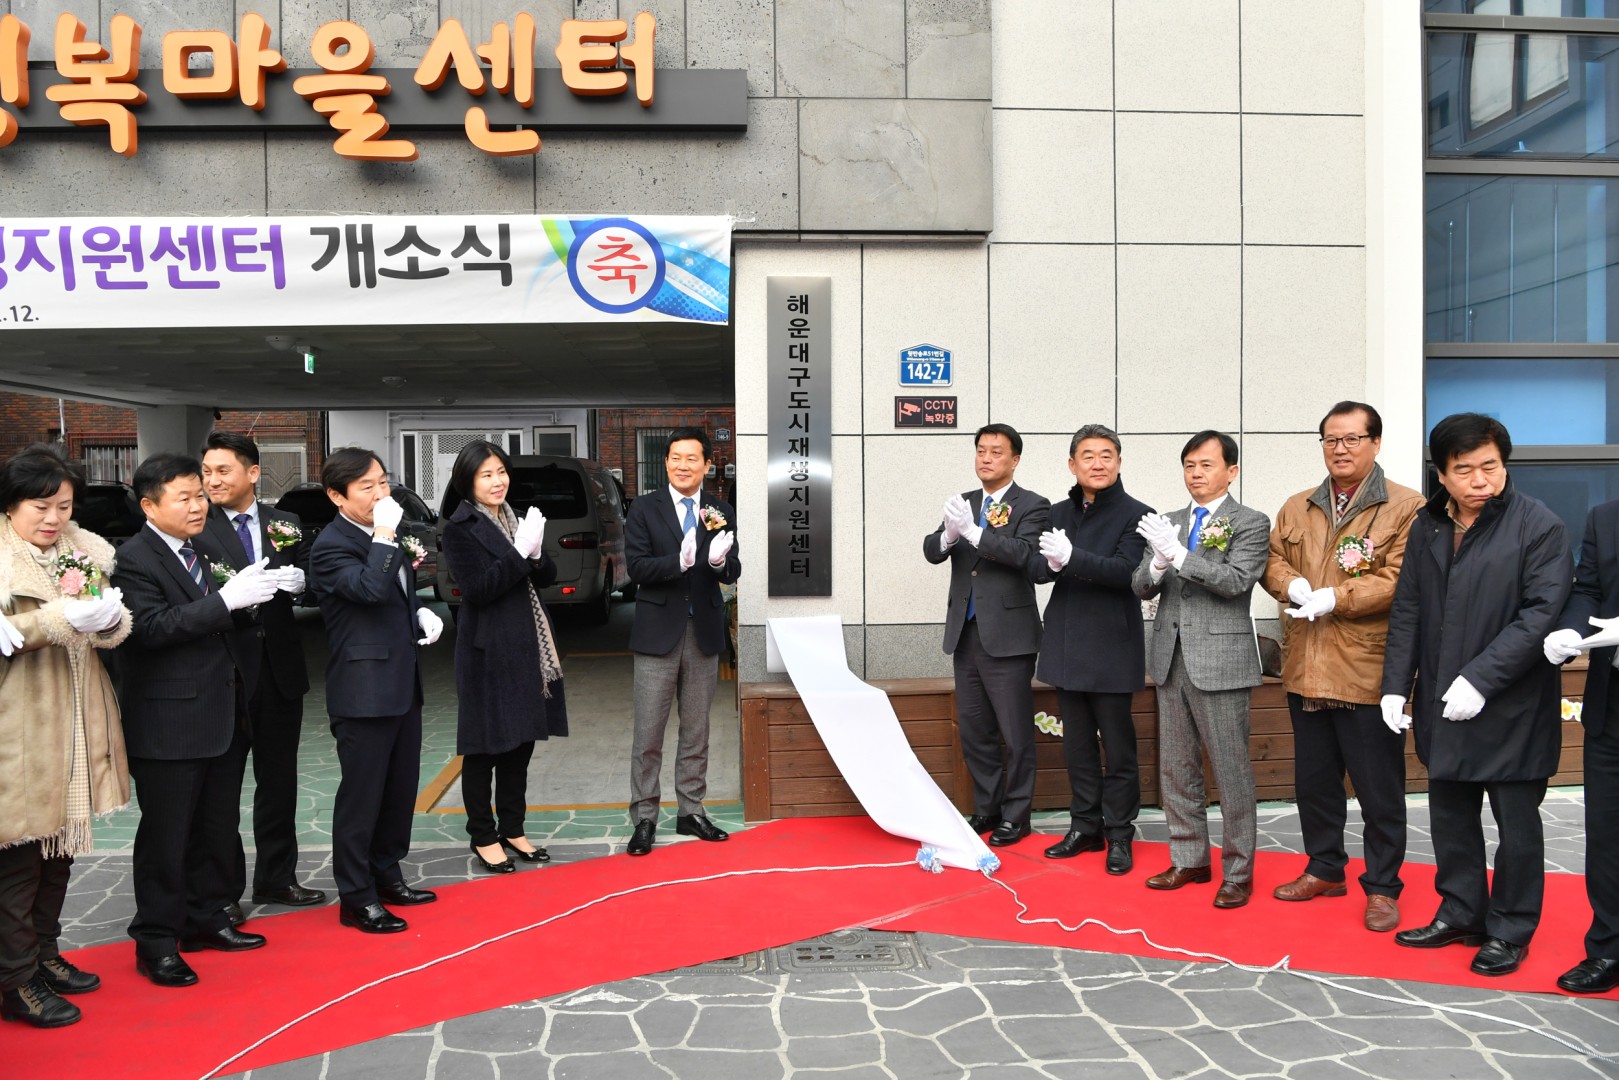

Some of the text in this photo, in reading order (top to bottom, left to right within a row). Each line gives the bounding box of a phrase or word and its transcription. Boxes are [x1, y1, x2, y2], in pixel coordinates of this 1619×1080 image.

[310, 224, 513, 289] 개소식
[587, 235, 650, 295] 축
[907, 363, 945, 380] 142-7
[924, 400, 955, 410] CCTV
[924, 413, 955, 425] 녹화중
[787, 294, 811, 578] 해운대구도시재생지원센터
